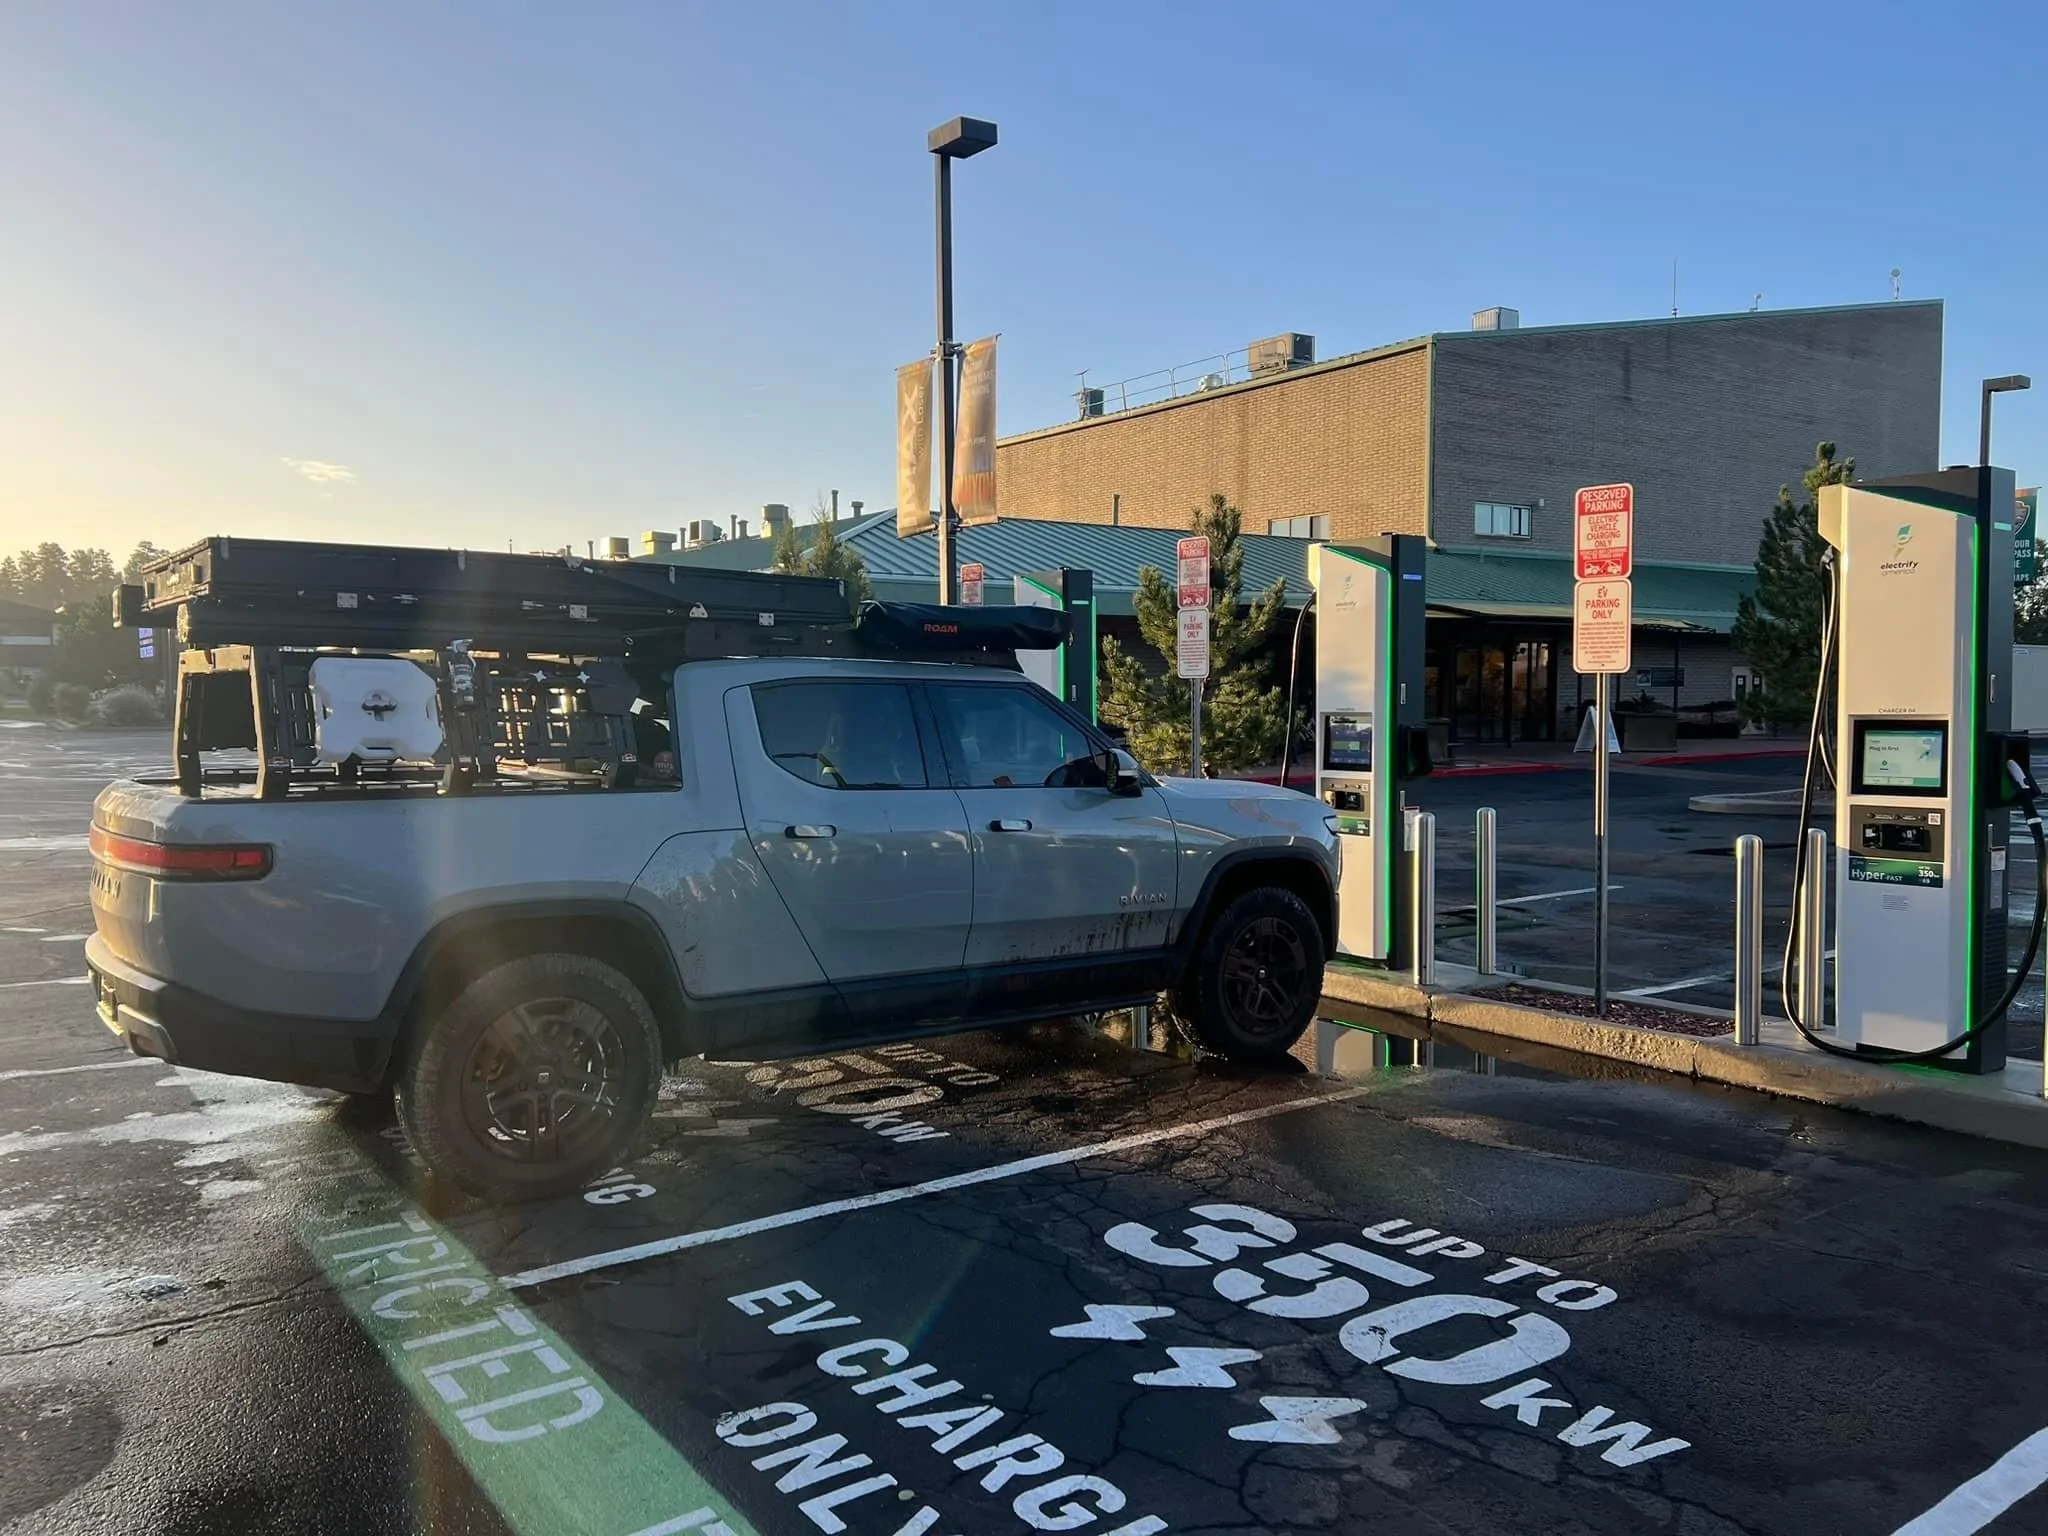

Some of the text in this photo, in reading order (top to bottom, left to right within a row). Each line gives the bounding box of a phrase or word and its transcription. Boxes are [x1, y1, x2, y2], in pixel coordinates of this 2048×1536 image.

[1582, 488, 1627, 501] RESERVED
[1584, 499, 1624, 512] PARKING
[1588, 514, 1620, 524] ELECTRIC
[1590, 523, 1617, 532] VEHICLE
[1586, 530, 1621, 540] CHARGING
[1594, 539, 1612, 548] ONLY
[2014, 539, 2030, 549] OUR
[1880, 560, 1920, 570] electrify
[1597, 588, 1608, 598] EV
[1585, 598, 1620, 609] PARKING
[1591, 609, 1613, 619] ONLY
[923, 622, 958, 633] ROAM
[1119, 892, 1167, 905] RIVIAN
[1362, 1219, 1619, 1311] UP TO
[1104, 1204, 1571, 1385] 350
[727, 1280, 861, 1335] EV
[1480, 1379, 1692, 1468] KW
